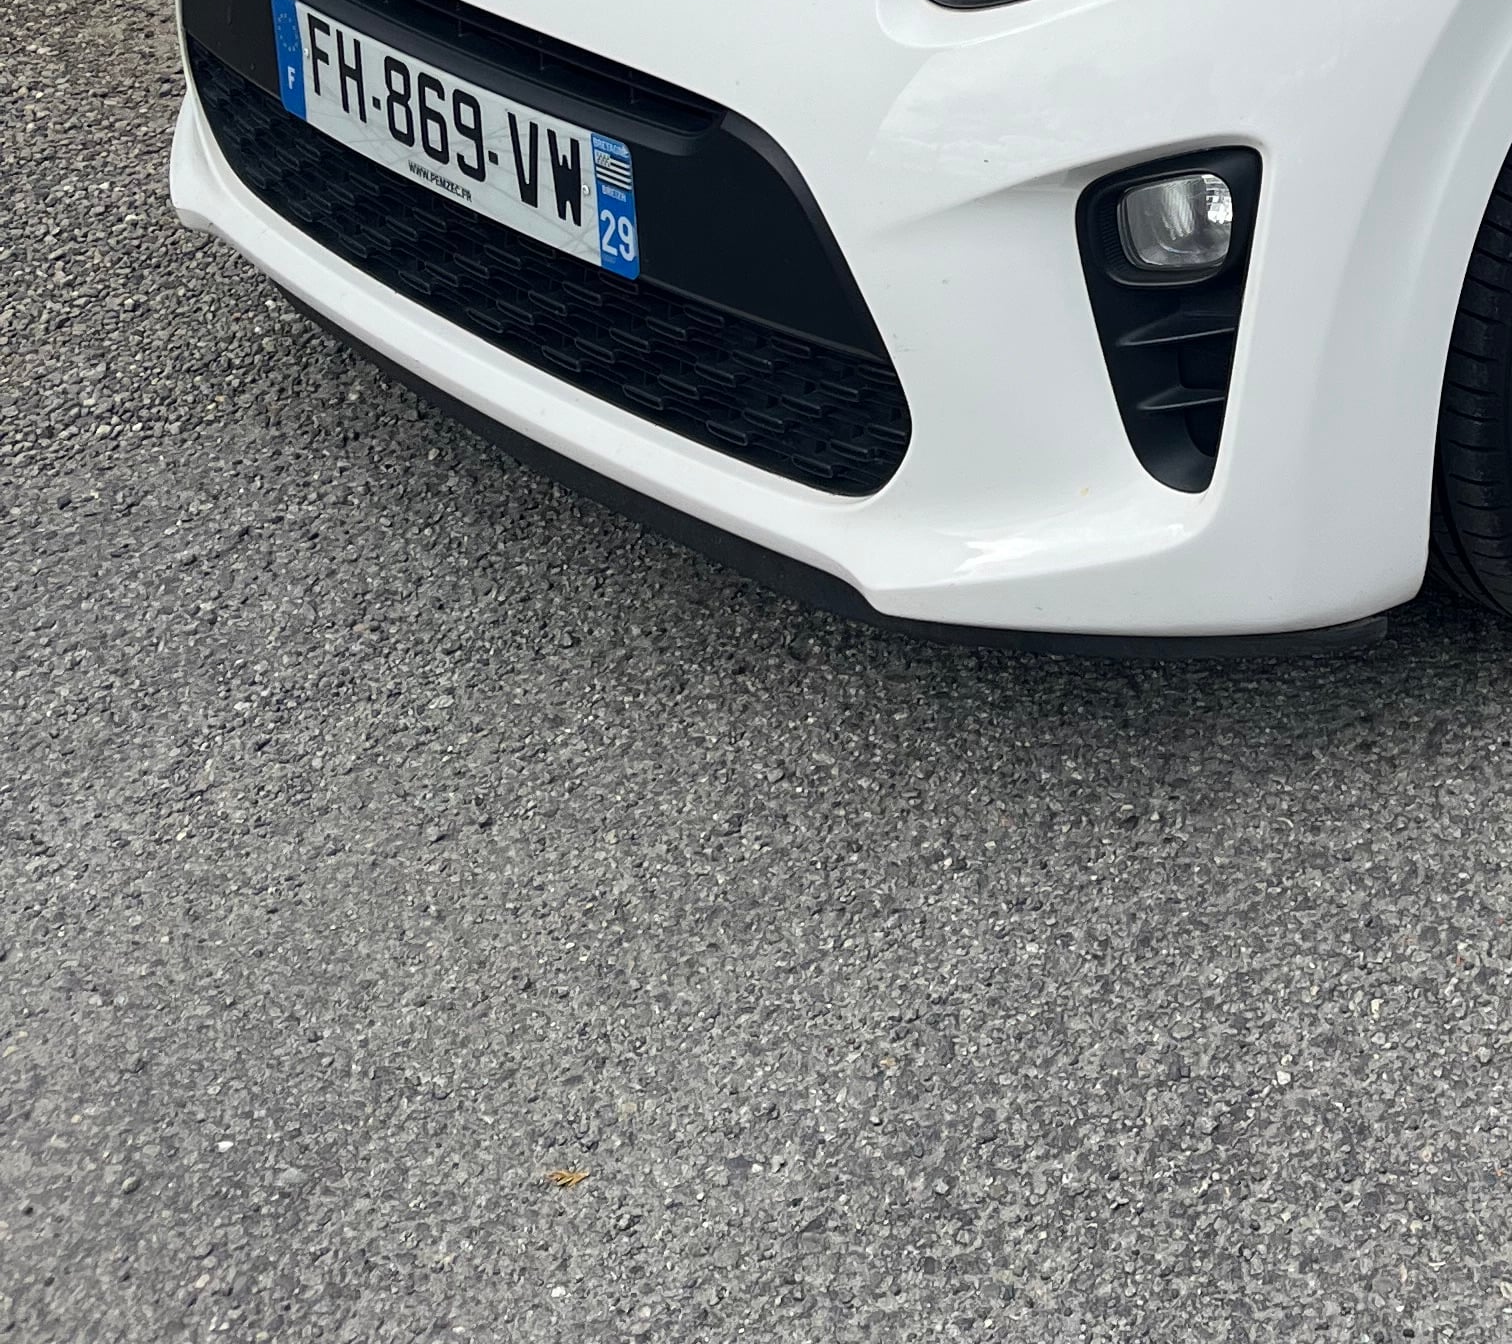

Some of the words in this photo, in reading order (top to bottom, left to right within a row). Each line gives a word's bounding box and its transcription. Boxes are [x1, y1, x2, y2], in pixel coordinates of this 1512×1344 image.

[287, 66, 296, 90] F
[307, 13, 582, 227] FH-869-VW
[600, 209, 637, 262] 29
